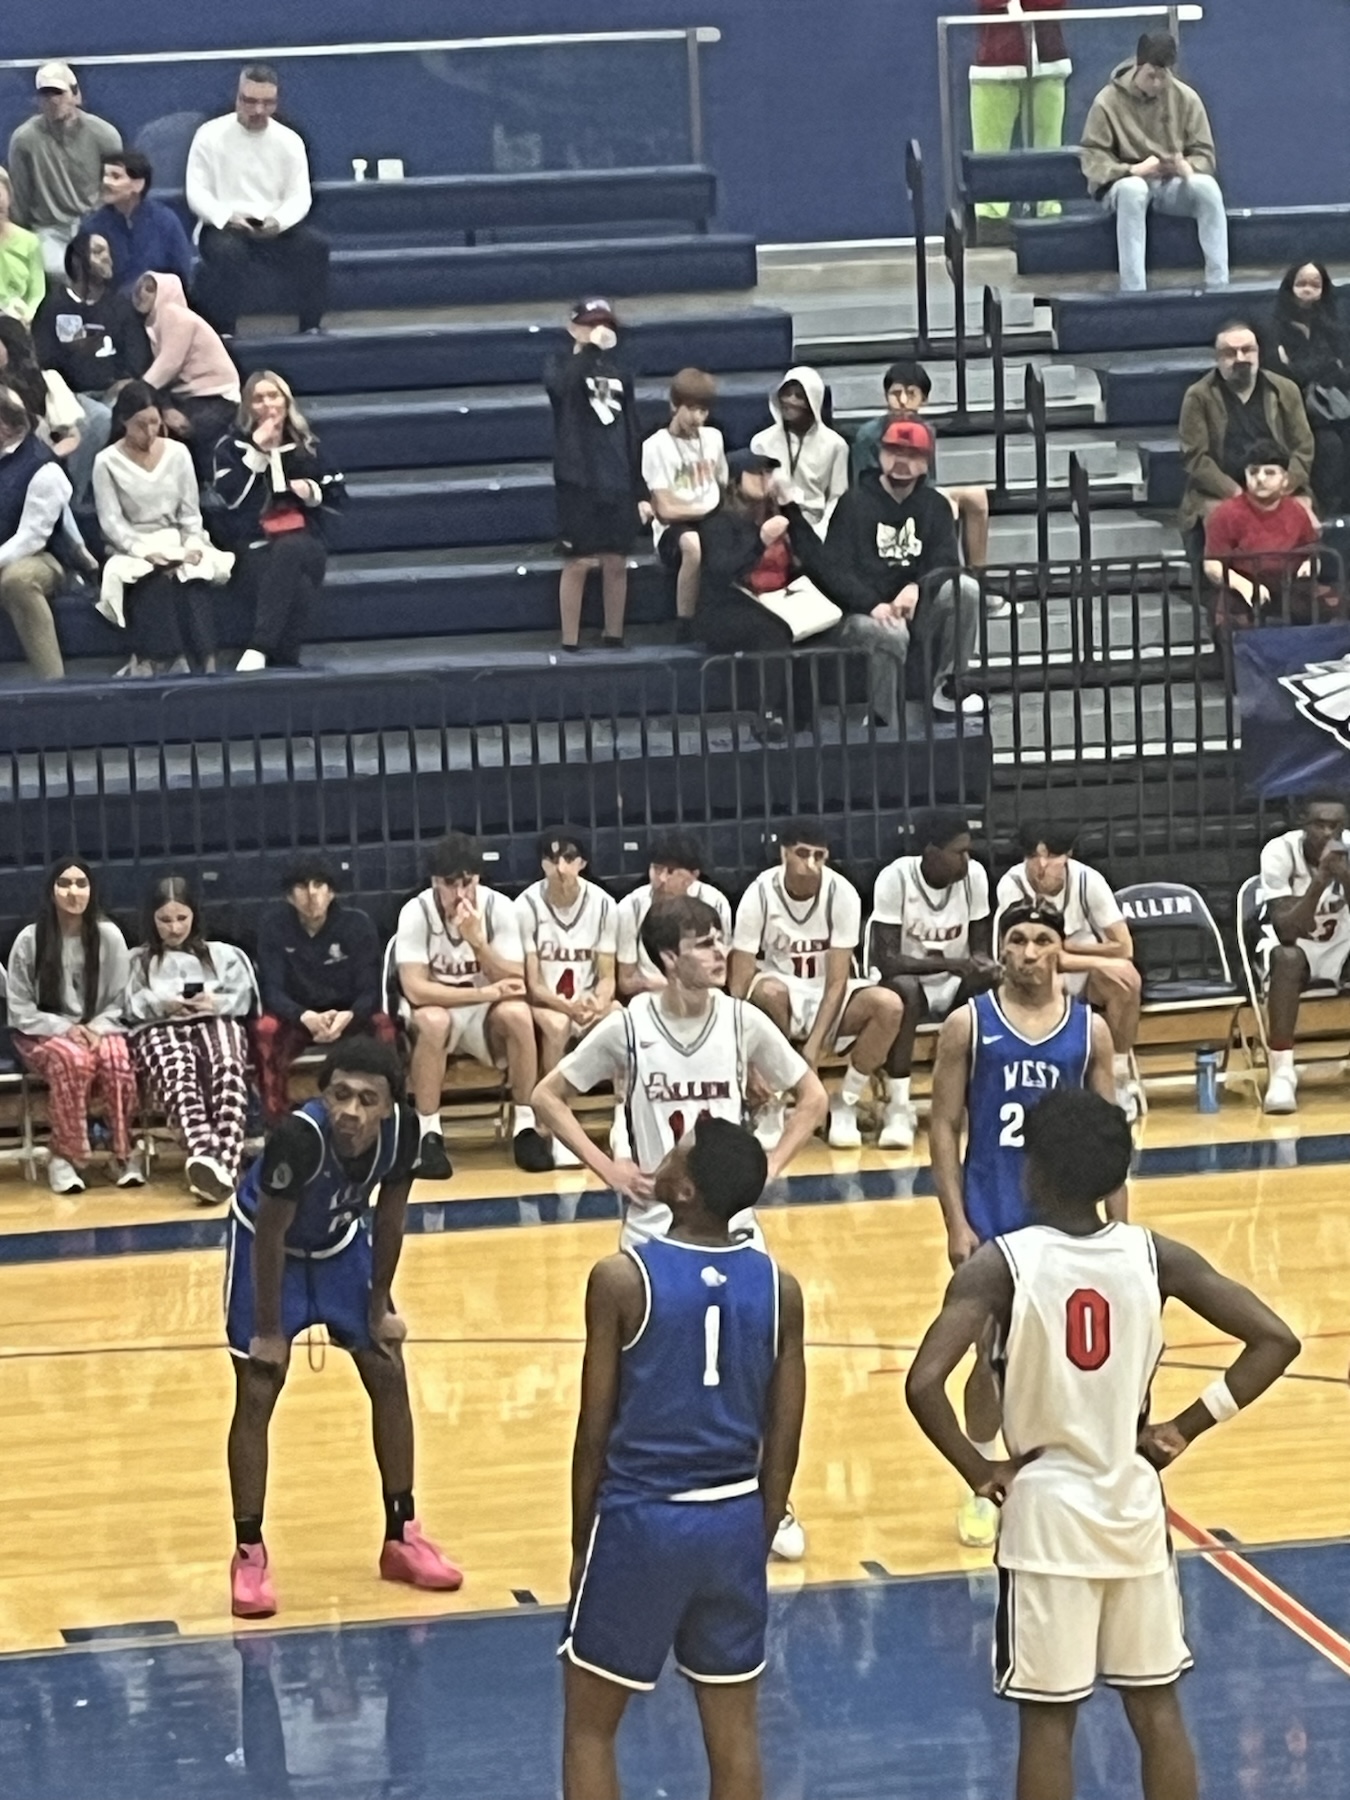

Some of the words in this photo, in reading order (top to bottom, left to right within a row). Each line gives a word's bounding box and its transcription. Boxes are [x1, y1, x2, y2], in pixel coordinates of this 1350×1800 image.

[1122, 896, 1193, 919] ALLEN
[556, 967, 576, 1000] 4
[791, 955, 817, 979] 11
[645, 1071, 730, 1102] ALLEN
[1003, 1059, 1060, 1092] WEST
[703, 1304, 720, 1386] 1
[1065, 1288, 1110, 1371] 0
